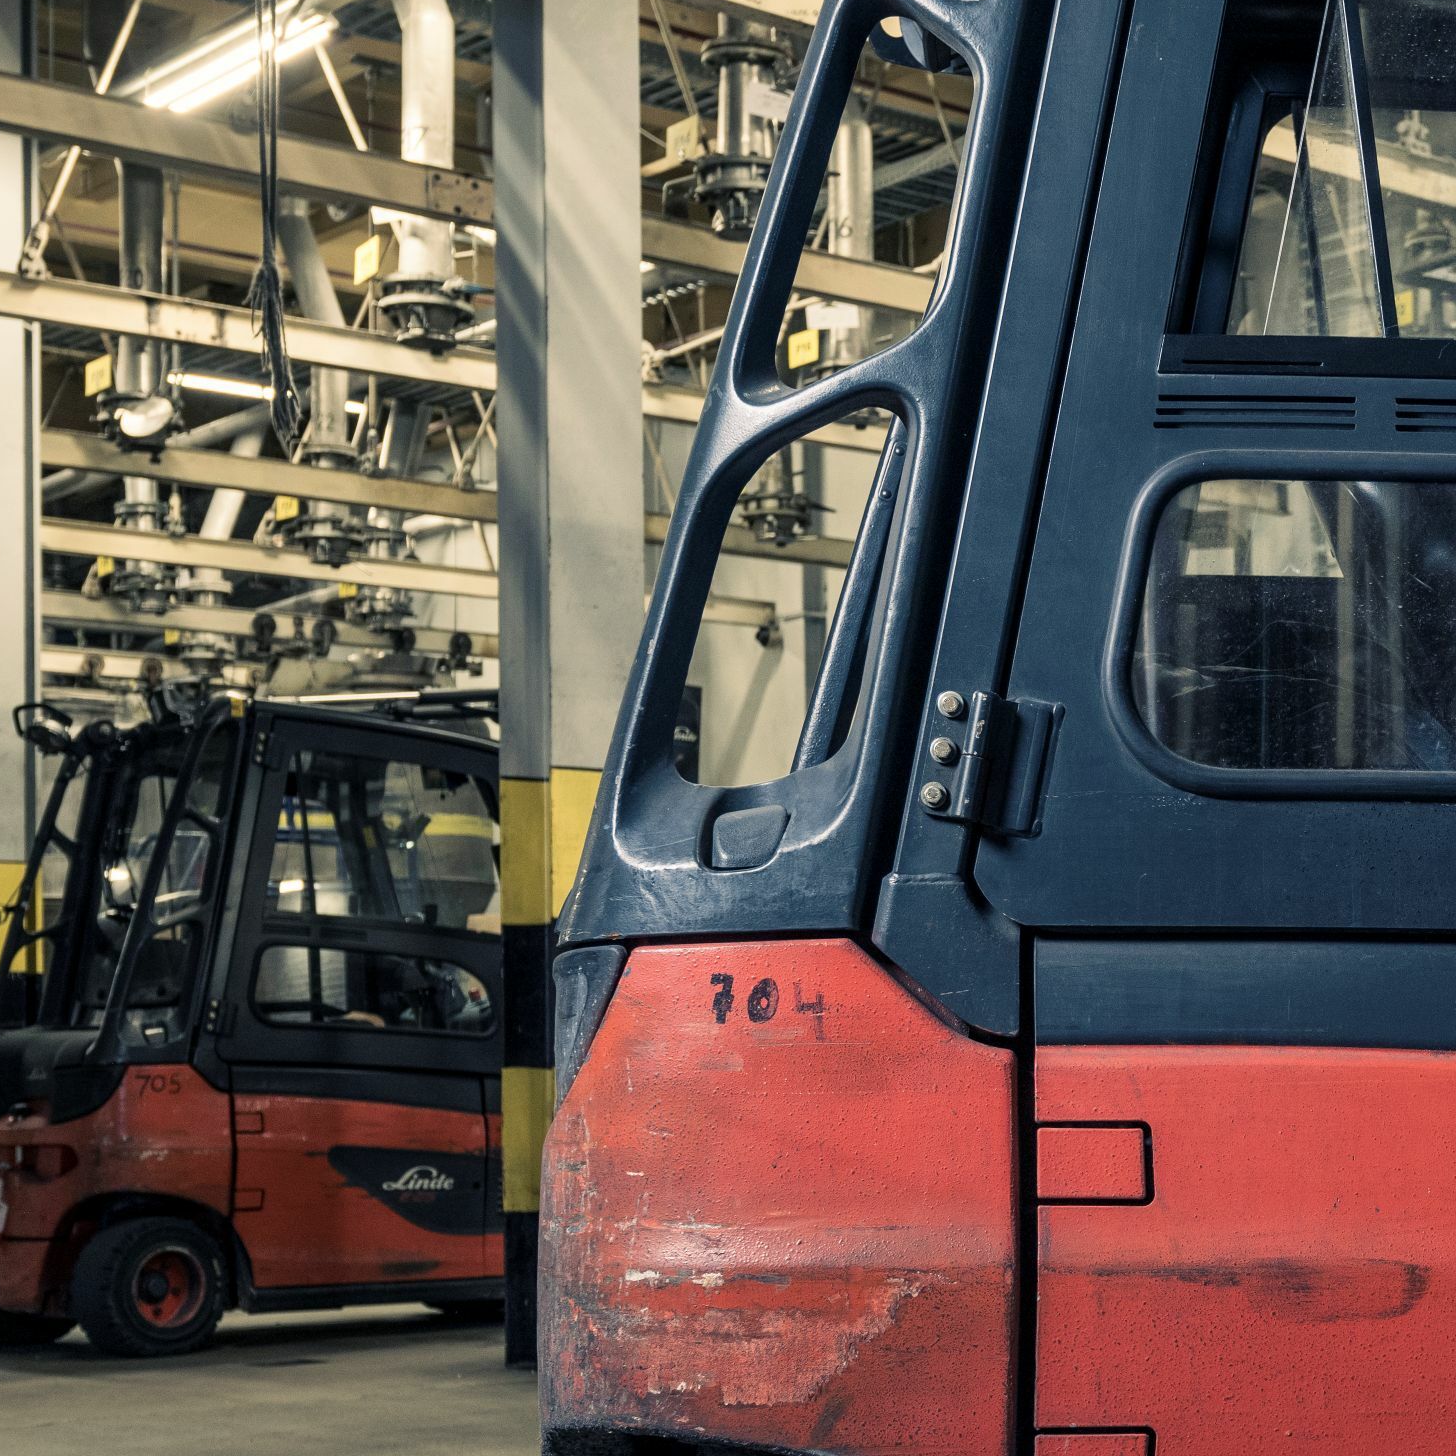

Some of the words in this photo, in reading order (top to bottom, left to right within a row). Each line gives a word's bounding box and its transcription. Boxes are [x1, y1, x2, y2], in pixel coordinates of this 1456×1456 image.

[710, 972, 828, 1042] 704
[134, 1073, 181, 1097] 705
[381, 1165, 455, 1191] Linde
